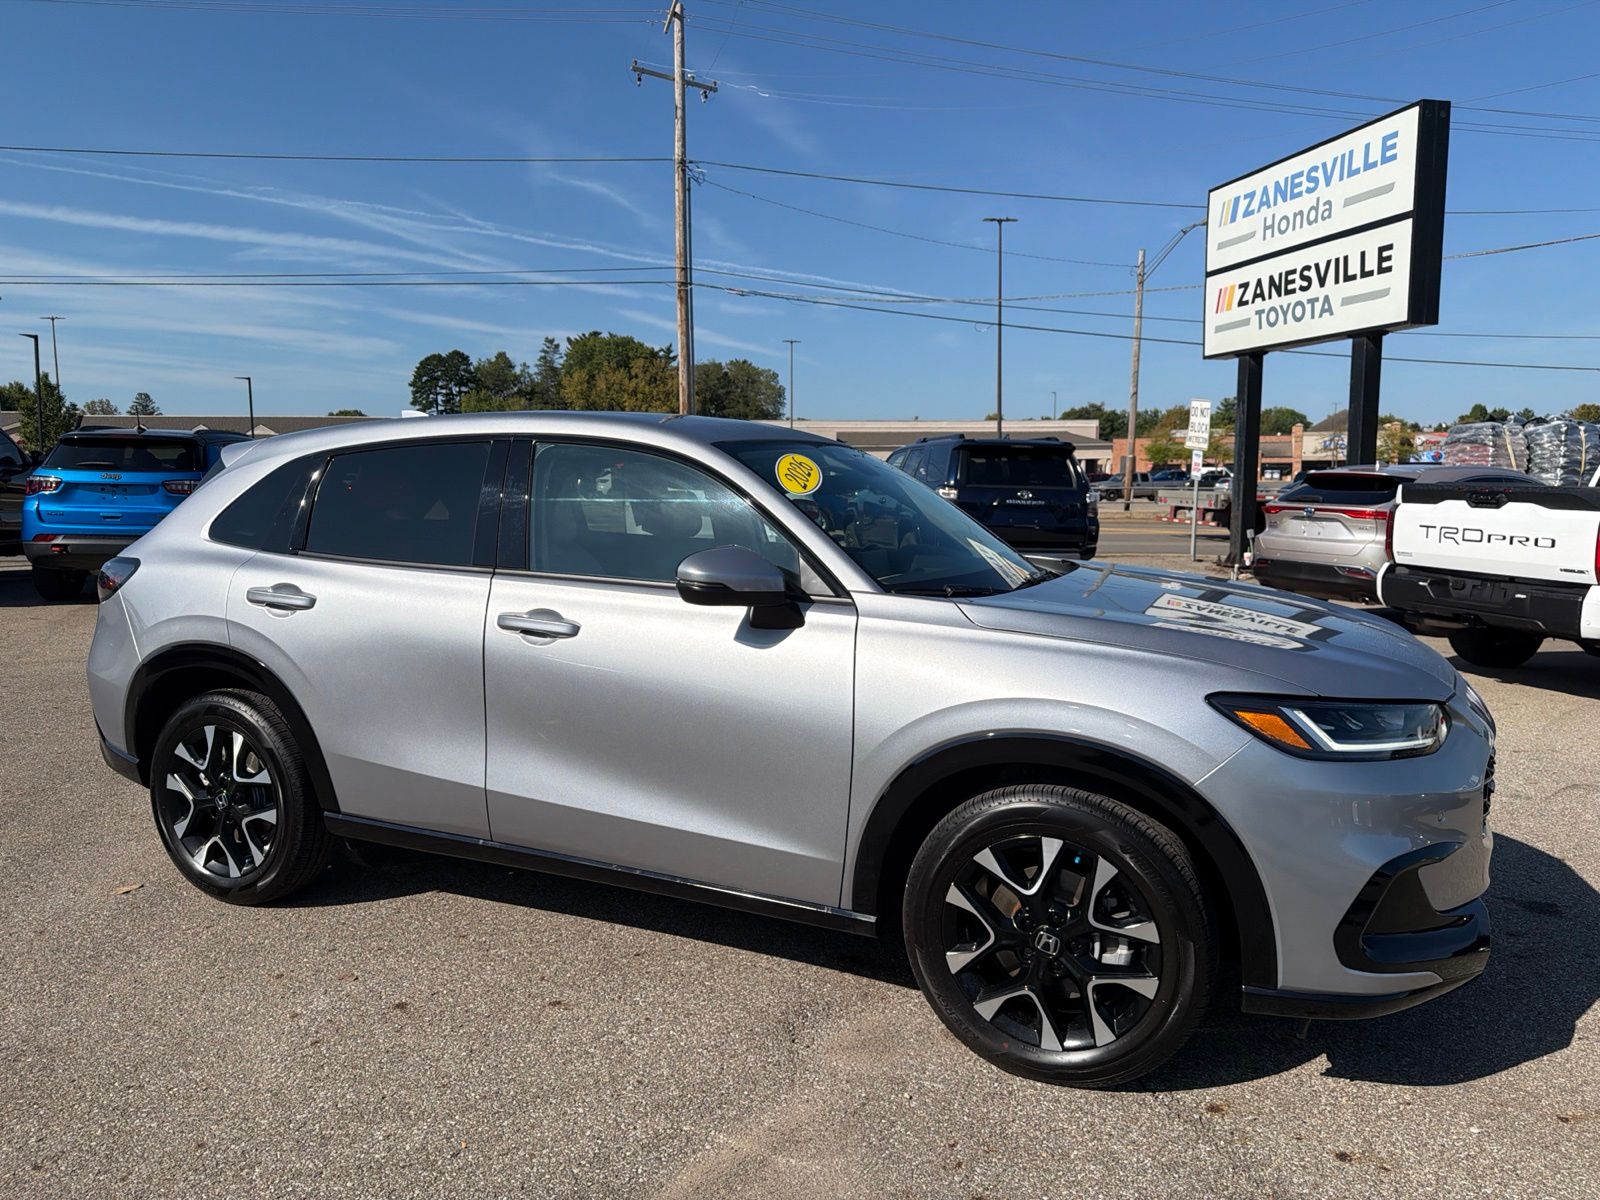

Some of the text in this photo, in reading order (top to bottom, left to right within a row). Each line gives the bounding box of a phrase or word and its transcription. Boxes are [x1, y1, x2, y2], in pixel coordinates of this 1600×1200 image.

[1242, 130, 1399, 219] ZANESVILLE
[1262, 197, 1333, 242] Honda
[1237, 243, 1394, 308] ZANESVILLE
[1255, 294, 1334, 330] TOYOTA
[784, 456, 813, 491] 2026
